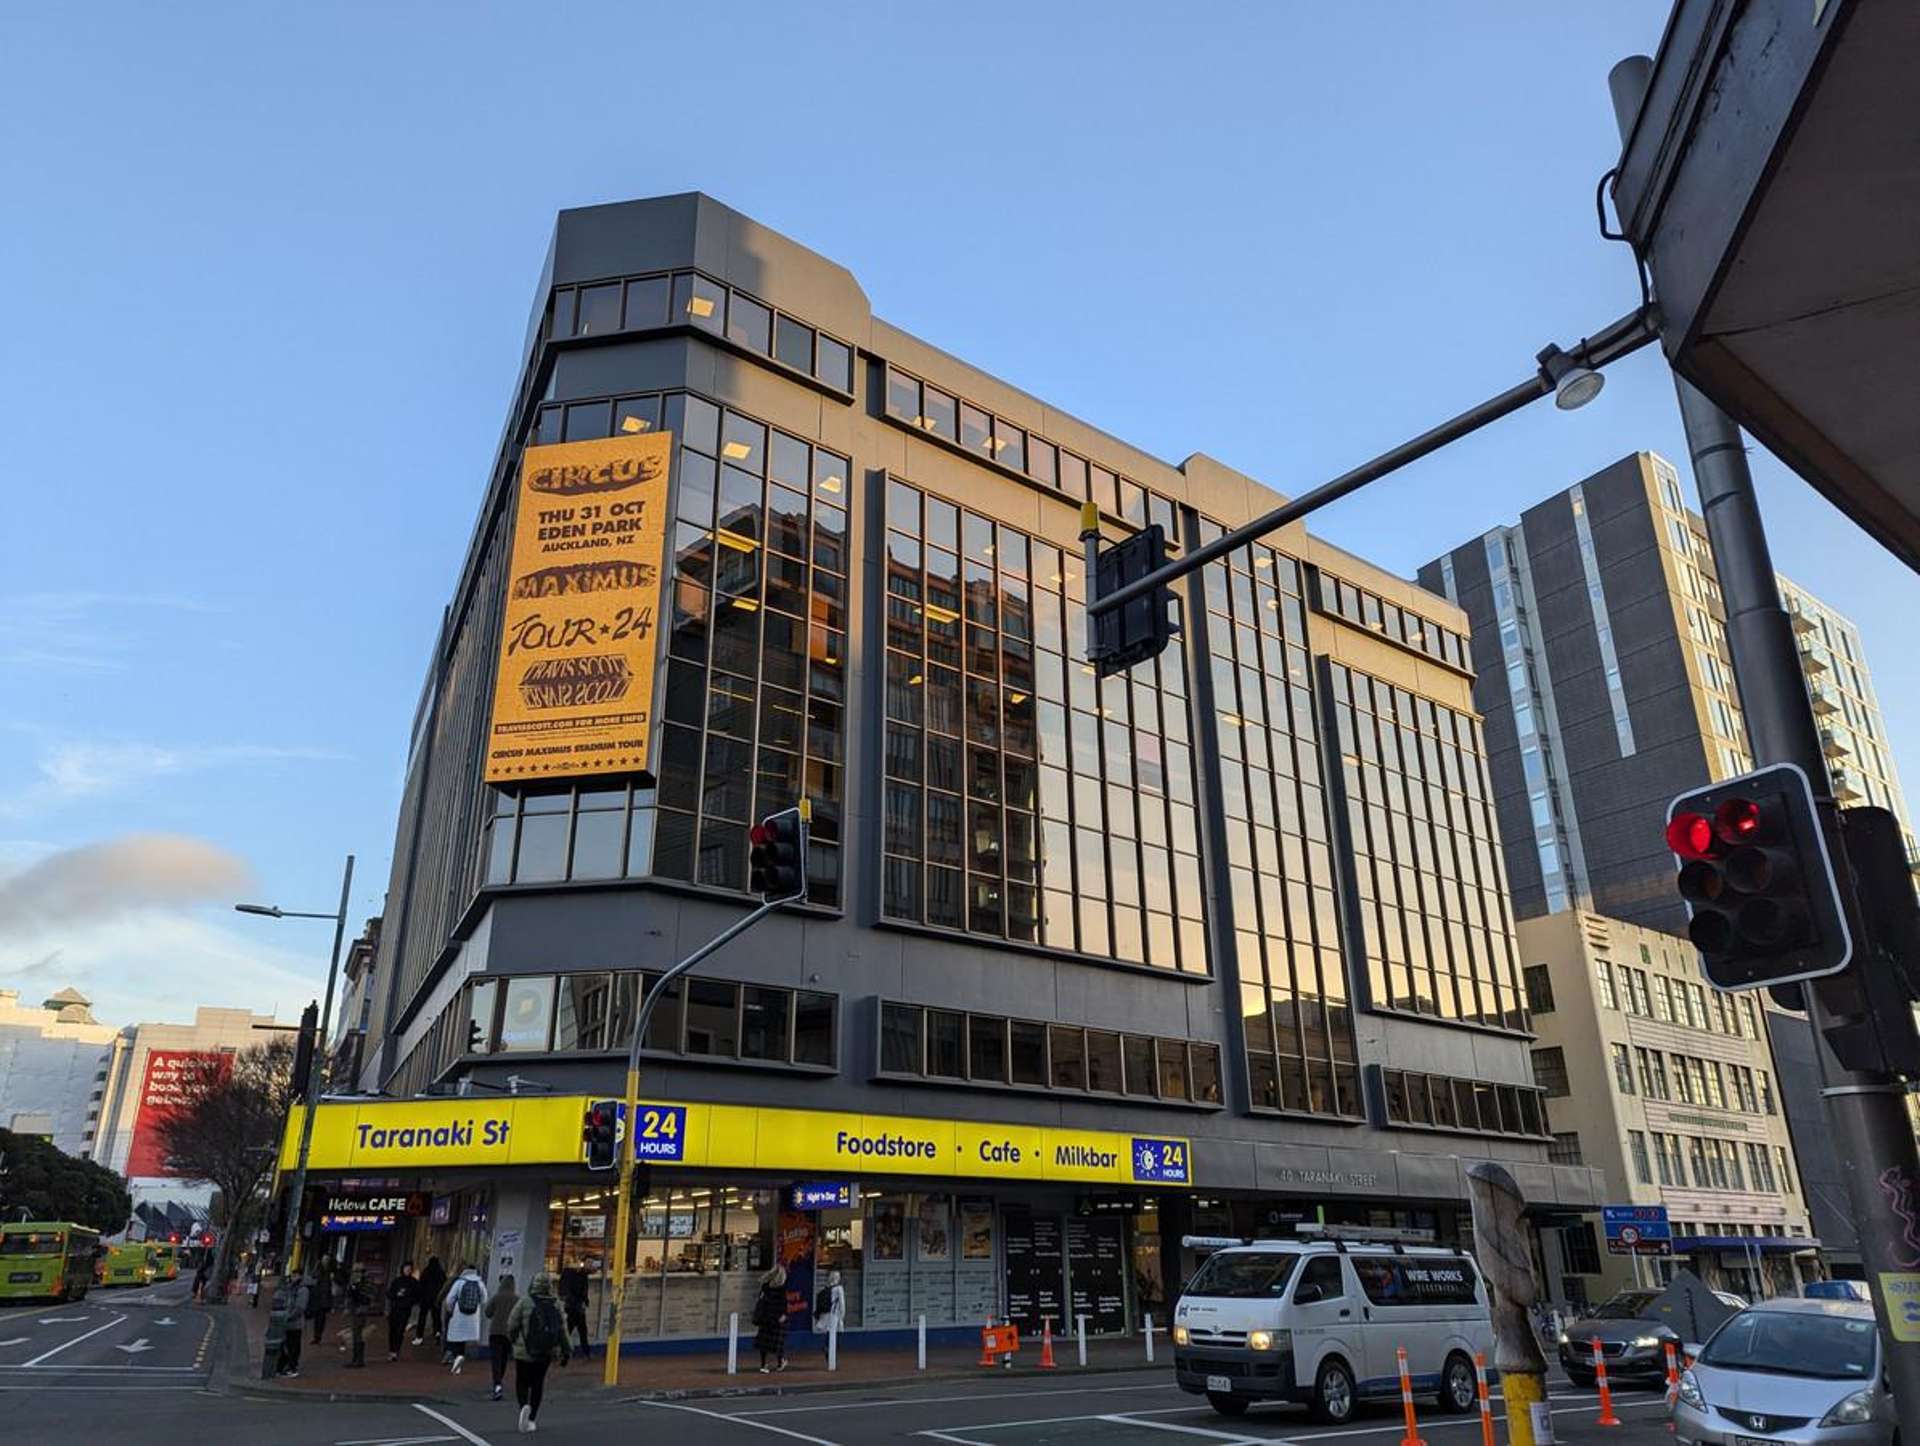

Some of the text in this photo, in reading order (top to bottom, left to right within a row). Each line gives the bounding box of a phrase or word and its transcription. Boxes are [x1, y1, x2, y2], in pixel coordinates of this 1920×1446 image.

[529, 456, 662, 494] CIRCUS
[539, 501, 645, 524] THU 31 OCT
[538, 518, 642, 541] EDEN PARK
[542, 535, 635, 552] AUCKLAND, NZ
[512, 561, 656, 600] MAXIMUS
[508, 607, 652, 656] TOUR 24
[358, 1119, 510, 1149] Taranaki St
[642, 1111, 677, 1139] 24
[640, 1142, 677, 1154] HOURS
[837, 1131, 1117, 1168] Foodstore Cafe Milkbar
[1163, 1145, 1183, 1166] 24
[1163, 1169, 1185, 1178] HOURS
[368, 1198, 406, 1211] CAFE
[1405, 1270, 1463, 1281] WIRE WORKS
